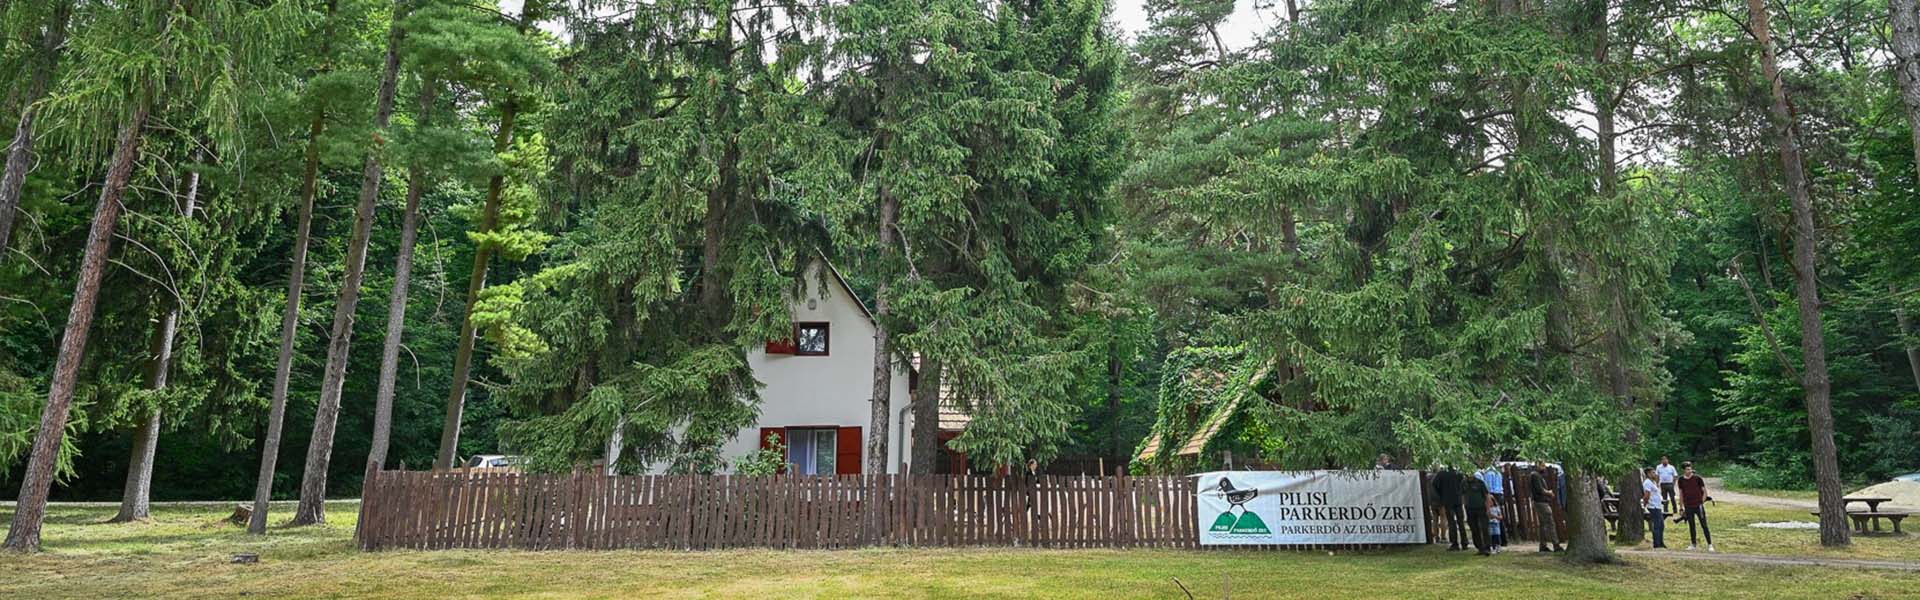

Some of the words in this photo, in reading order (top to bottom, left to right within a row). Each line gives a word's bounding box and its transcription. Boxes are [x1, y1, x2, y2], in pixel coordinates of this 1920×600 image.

[1280, 492, 1328, 506] PILISI
[1280, 504, 1377, 521] PARKERDŐ
[1343, 525, 1357, 535] AZ
[1360, 524, 1416, 534] EMBERÉRT
